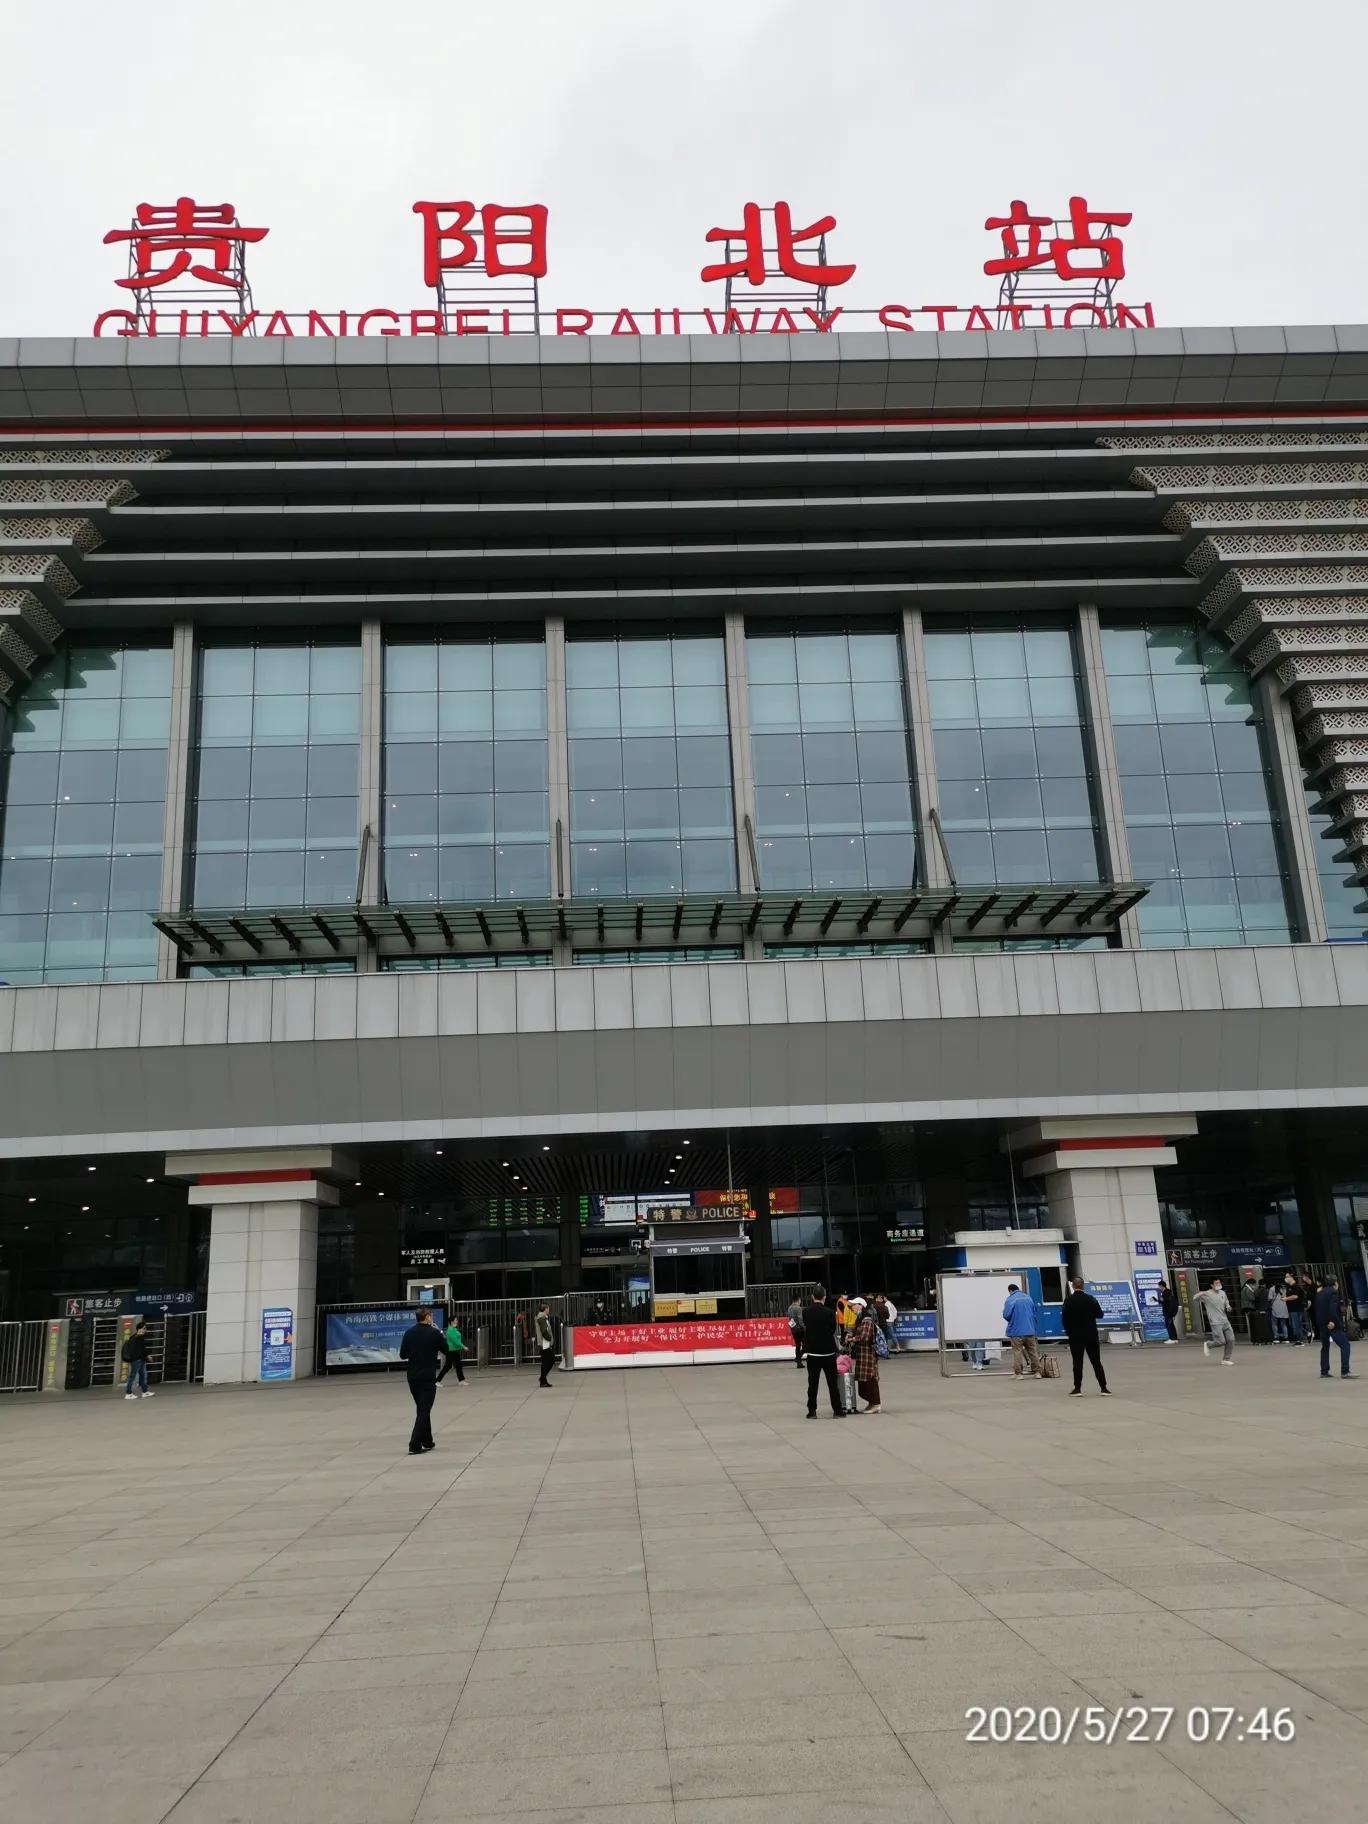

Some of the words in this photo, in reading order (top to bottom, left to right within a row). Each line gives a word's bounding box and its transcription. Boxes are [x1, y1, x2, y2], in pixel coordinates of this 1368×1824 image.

[103, 196, 1132, 288] 贵阳北站
[556, 307, 841, 336] RAILWAY
[879, 303, 1155, 332] STATION
[653, 1208, 682, 1221] 特警
[702, 1207, 740, 1218] POLICE
[1183, 1249, 1217, 1259] 旅客止步
[85, 1298, 122, 1309] 旅客止步
